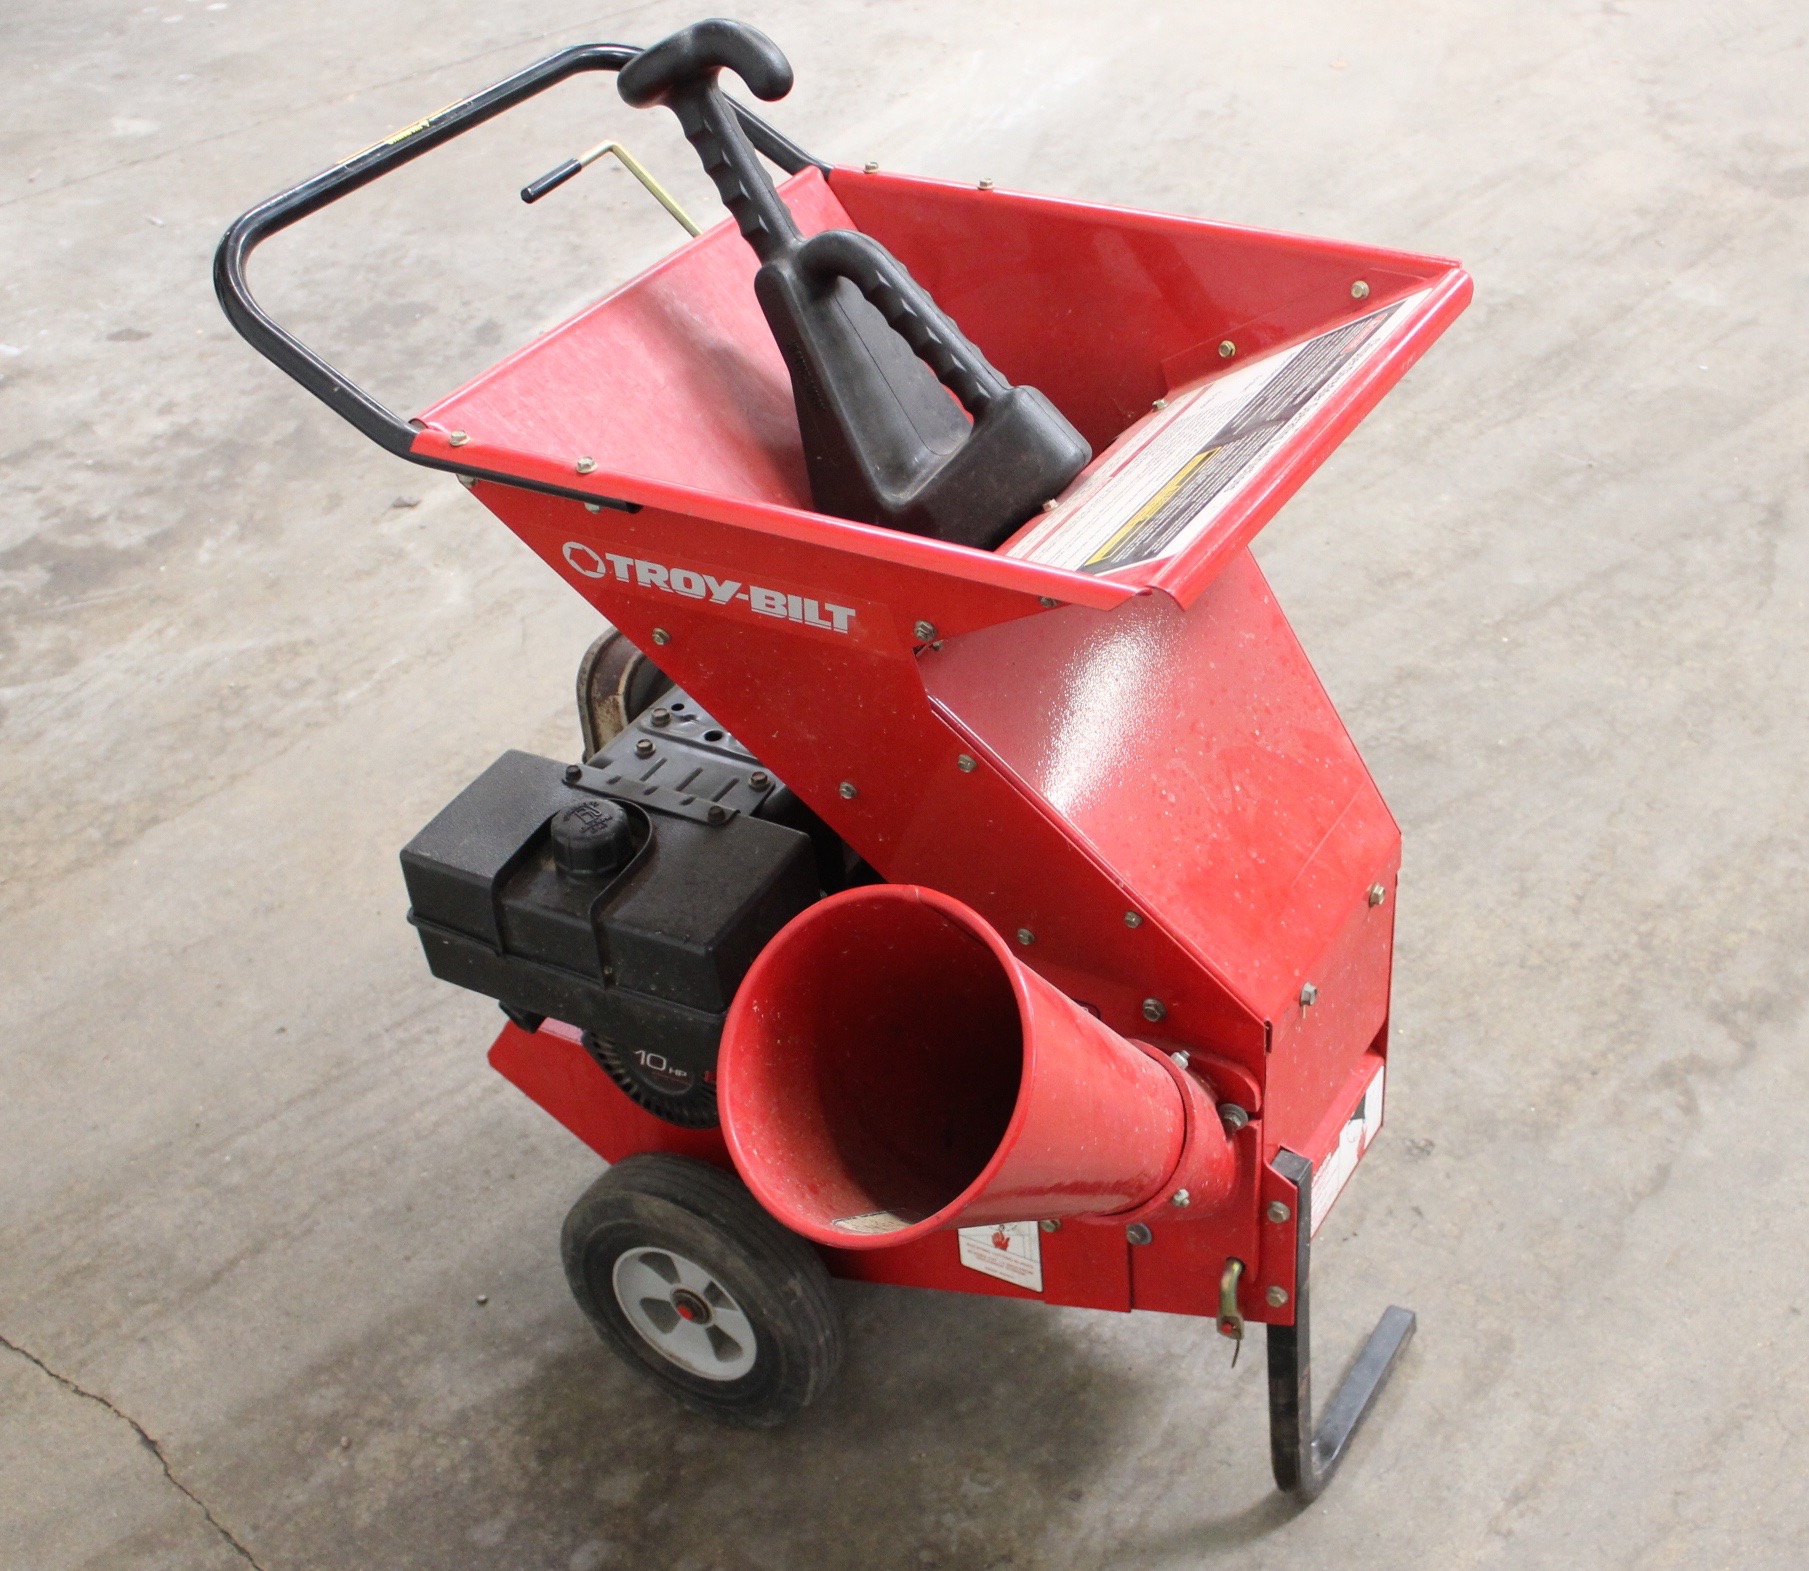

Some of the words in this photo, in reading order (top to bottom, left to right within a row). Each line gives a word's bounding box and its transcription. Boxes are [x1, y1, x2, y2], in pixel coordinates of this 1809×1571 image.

[606, 553, 856, 634] TROY-BILT
[634, 1050, 667, 1071] 10
[669, 1067, 688, 1077] HP
